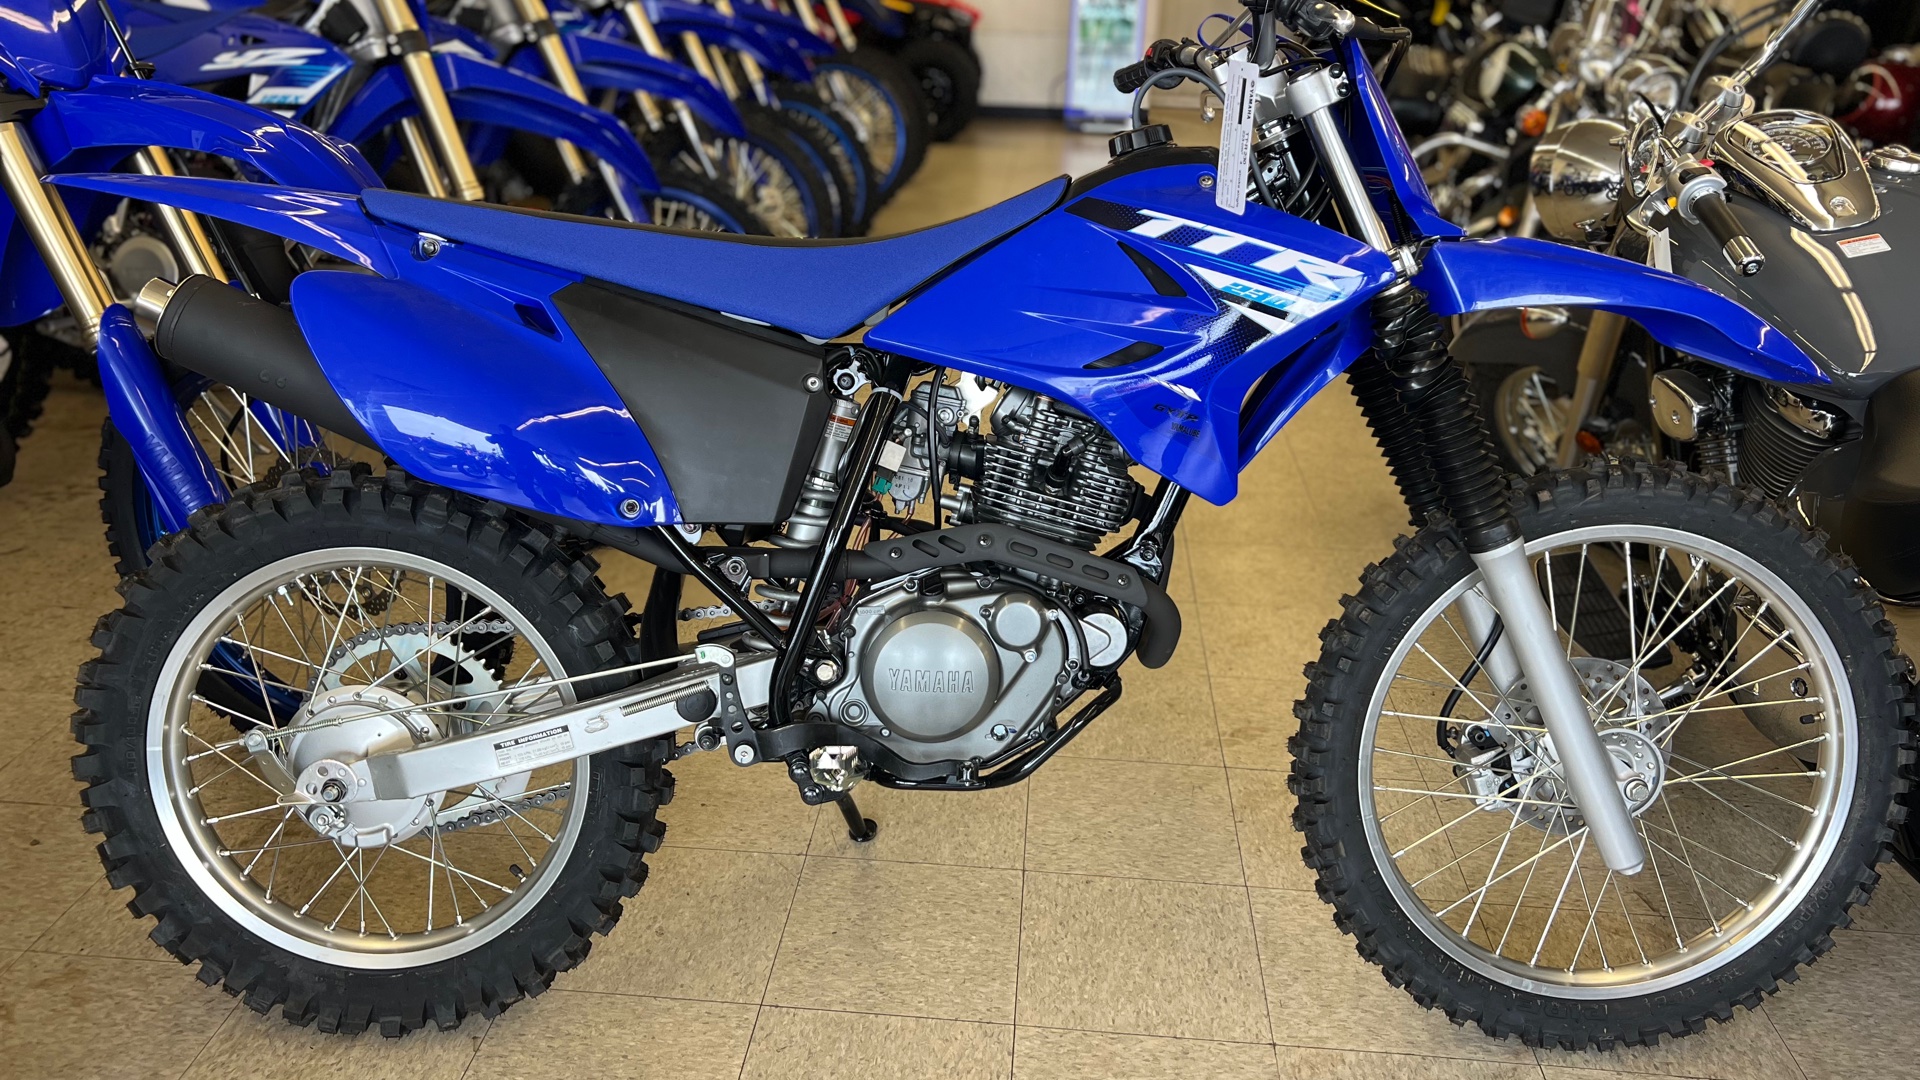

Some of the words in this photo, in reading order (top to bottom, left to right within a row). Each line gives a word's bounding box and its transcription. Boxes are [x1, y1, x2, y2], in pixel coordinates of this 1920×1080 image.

[200, 47, 326, 71] YZ
[1246, 89, 1255, 120] YAMAHA
[1219, 282, 1297, 310] 230
[1171, 421, 1200, 438] YAMALUBE
[145, 434, 204, 513] YAMAH
[888, 668, 974, 693] YAMAHA
[499, 740, 516, 748] TIRE
[517, 728, 563, 744] INFORMATION
